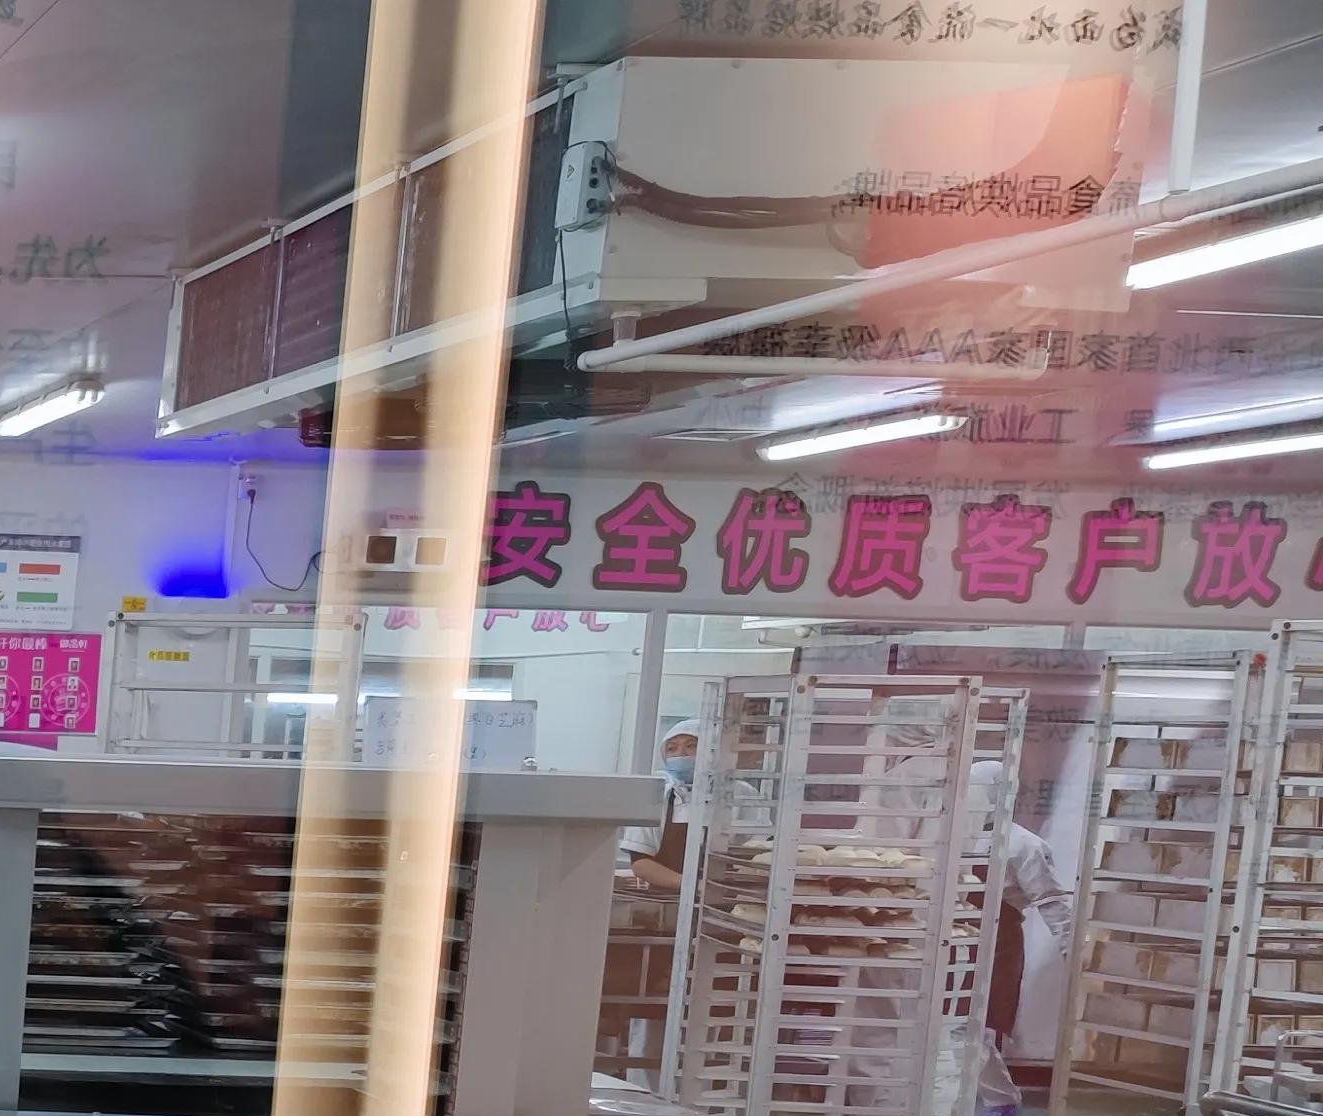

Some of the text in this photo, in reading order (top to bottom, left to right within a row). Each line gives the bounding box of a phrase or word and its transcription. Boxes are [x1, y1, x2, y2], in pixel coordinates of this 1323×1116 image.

[477, 480, 1323, 608] 安全优质客户放
